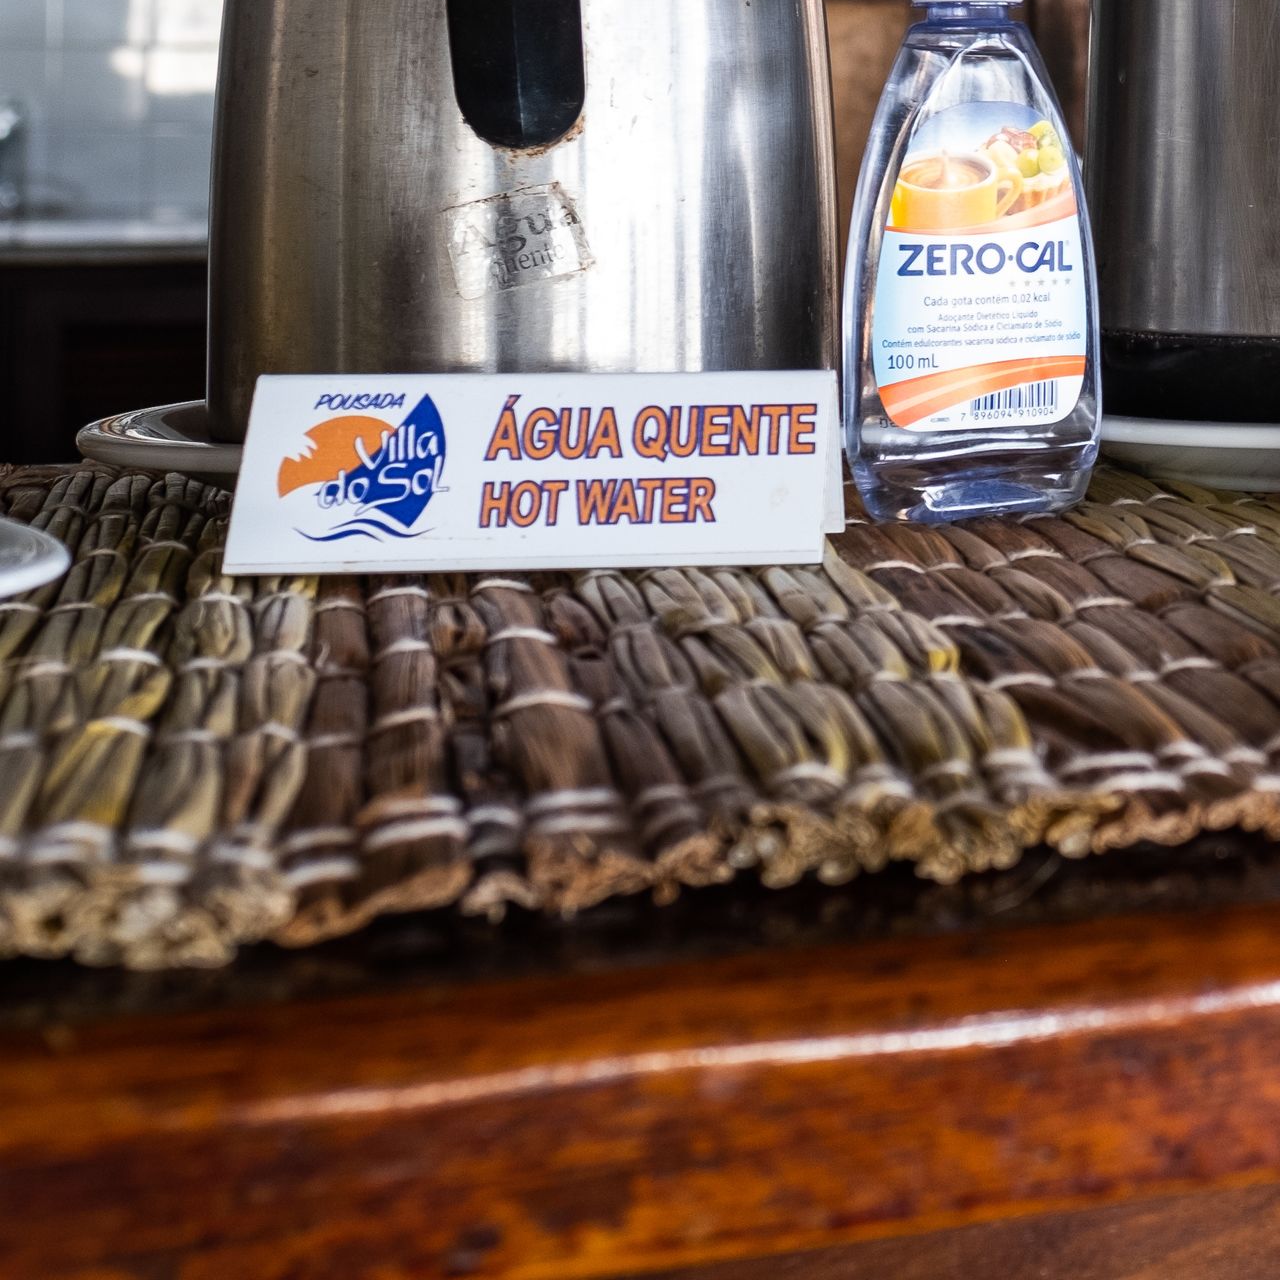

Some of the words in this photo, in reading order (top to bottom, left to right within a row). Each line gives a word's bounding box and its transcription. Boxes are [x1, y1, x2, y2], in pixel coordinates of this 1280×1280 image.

[923, 296, 948, 307] Cada
[1033, 292, 1050, 303] kcal
[887, 354, 914, 370] 100
[917, 353, 940, 369] mL
[313, 393, 406, 411] POUSADA
[973, 409, 1013, 421] 896094
[1018, 408, 1054, 418] 910904
[483, 394, 625, 462] ÁGUA
[631, 403, 818, 463] QUENTE
[354, 423, 439, 471] Villa
[317, 468, 371, 510] do
[353, 455, 451, 518] Sol
[479, 480, 567, 530] HOT
[576, 476, 717, 526] WATER
